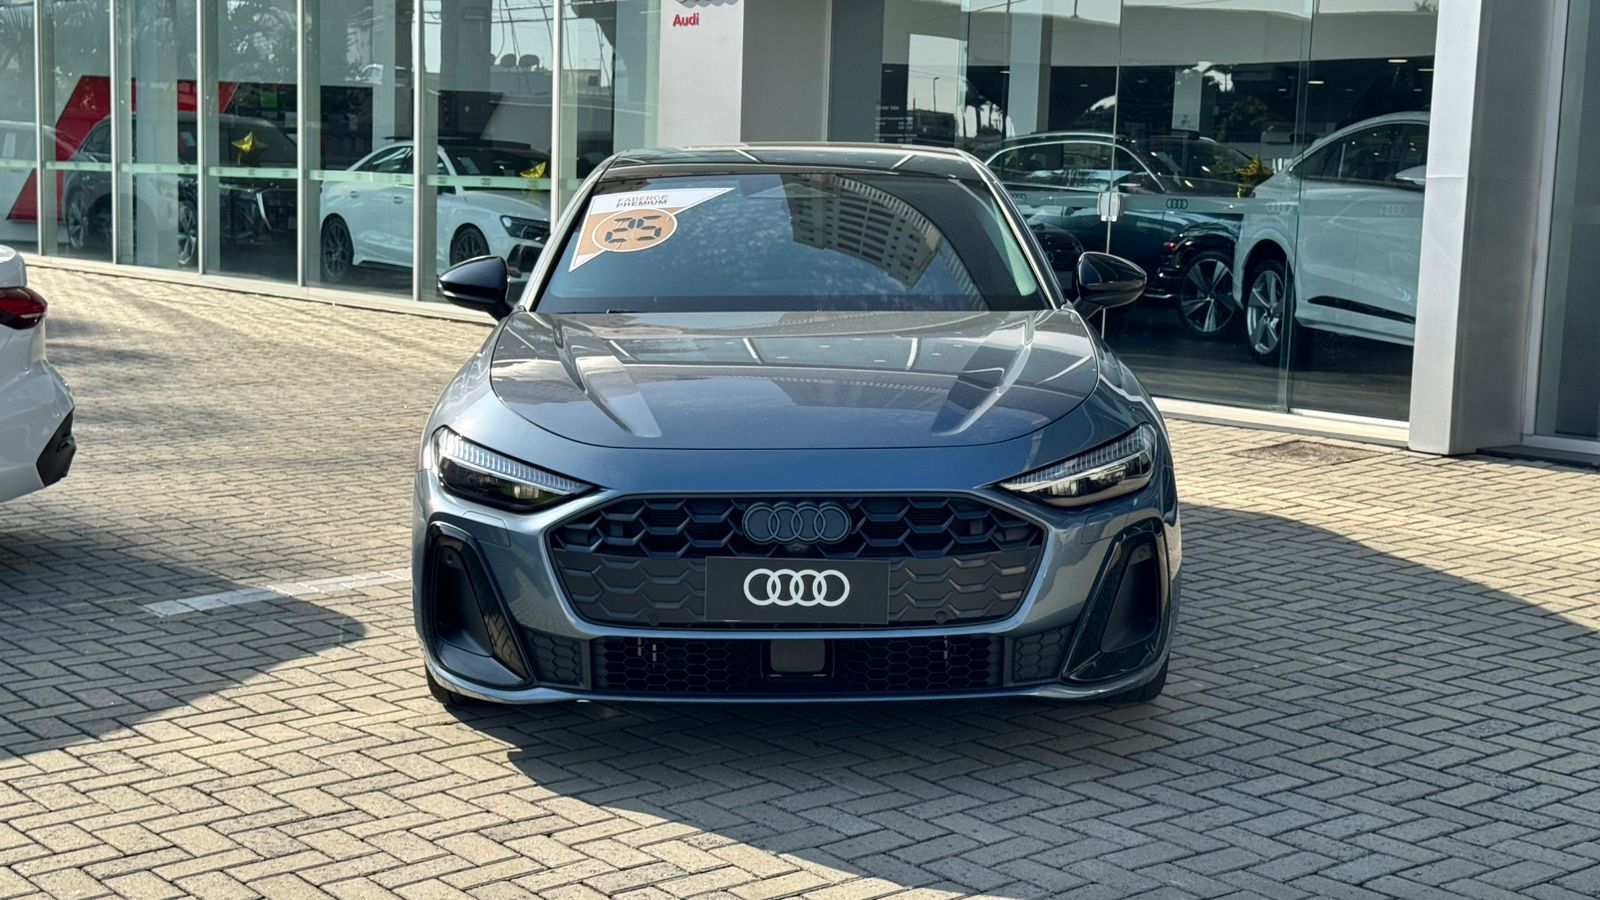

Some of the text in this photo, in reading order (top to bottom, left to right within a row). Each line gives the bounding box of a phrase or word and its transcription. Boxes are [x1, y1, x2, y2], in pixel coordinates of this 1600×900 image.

[673, 12, 700, 27] Audi
[616, 199, 667, 208] PREMIUM
[604, 215, 662, 243] 25
